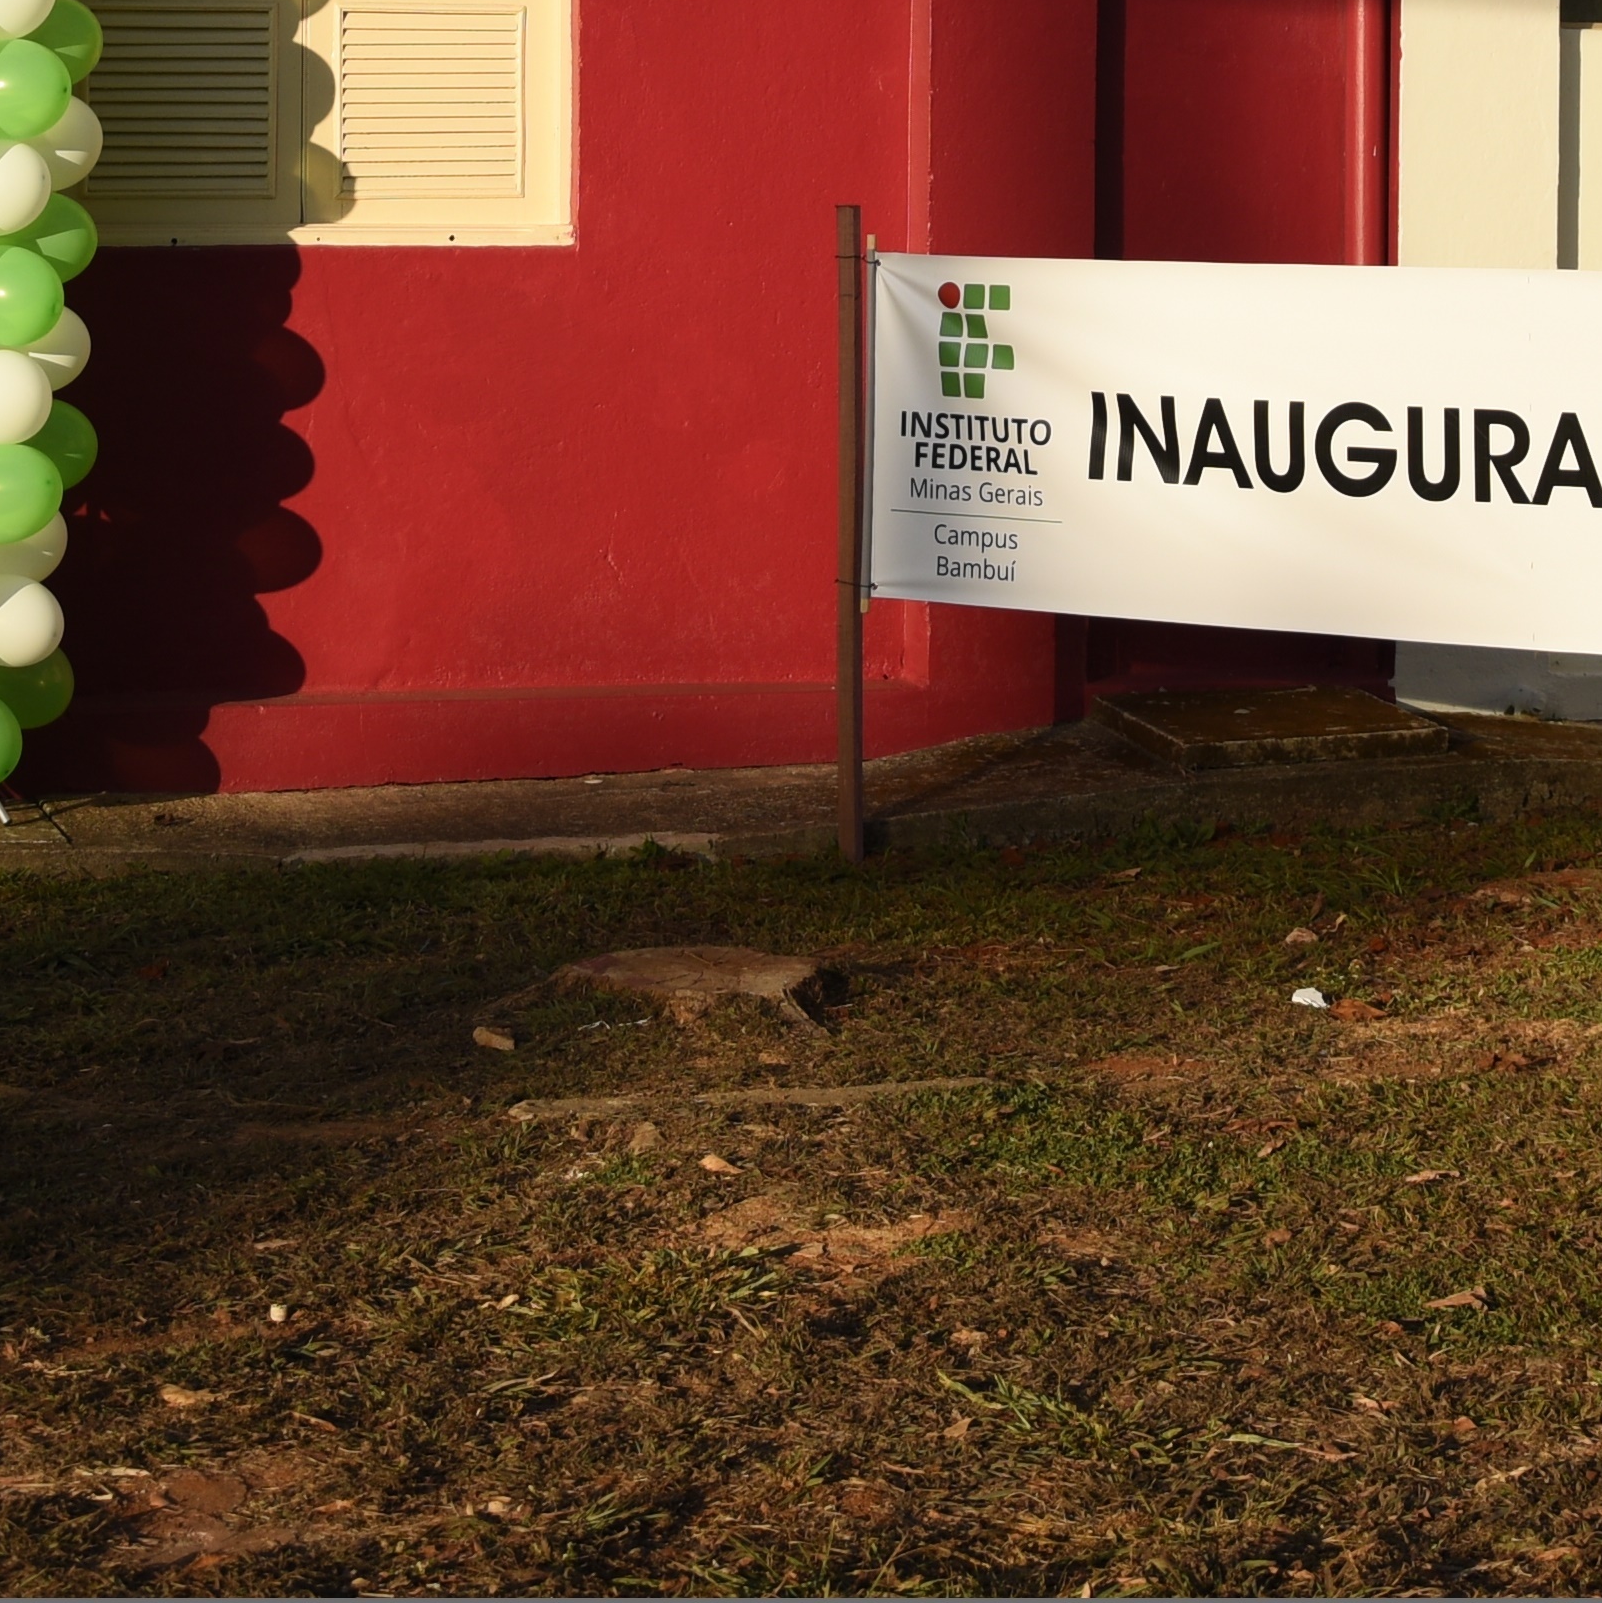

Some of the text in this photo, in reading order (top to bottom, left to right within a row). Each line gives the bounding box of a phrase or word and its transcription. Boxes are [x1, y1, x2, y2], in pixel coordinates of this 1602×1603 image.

[900, 410, 1052, 446] INSTITUTO
[914, 442, 1038, 476] FEDERAL
[909, 477, 1044, 506] Minas Gerais
[934, 524, 1019, 553] Campus
[936, 555, 1016, 582] Bambuí
